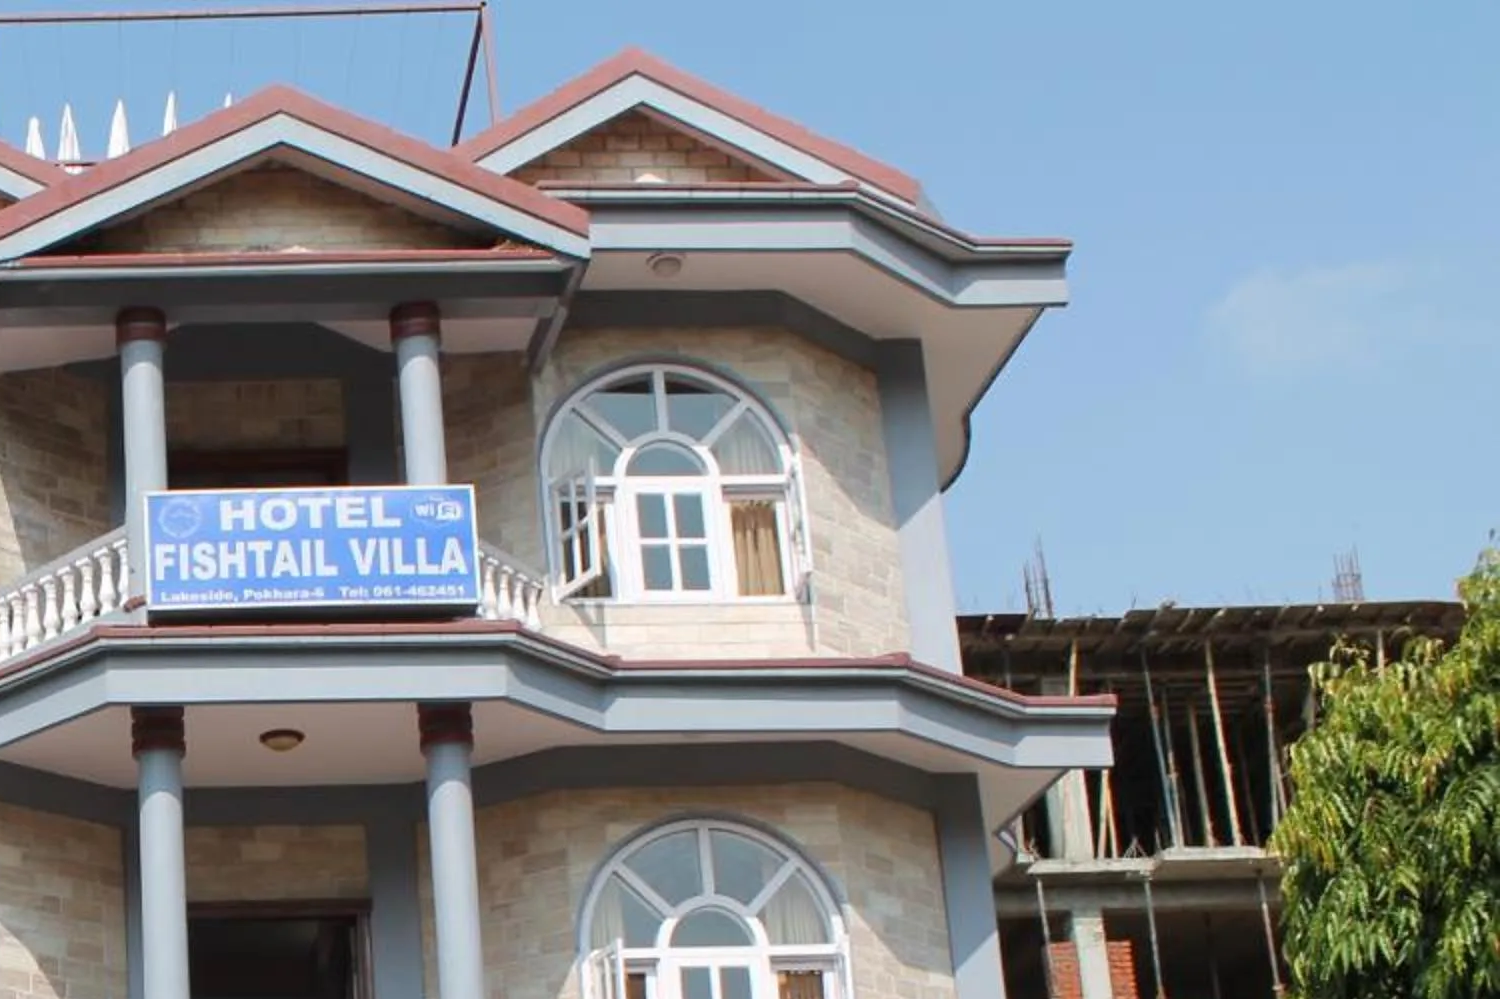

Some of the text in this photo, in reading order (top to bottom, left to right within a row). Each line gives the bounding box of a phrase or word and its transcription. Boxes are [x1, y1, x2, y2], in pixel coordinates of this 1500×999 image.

[219, 496, 402, 532] HOTEL
[154, 537, 469, 581] FISHTAIL VILLA
[160, 590, 239, 604] Lakeside,
[339, 585, 368, 598] Tel:
